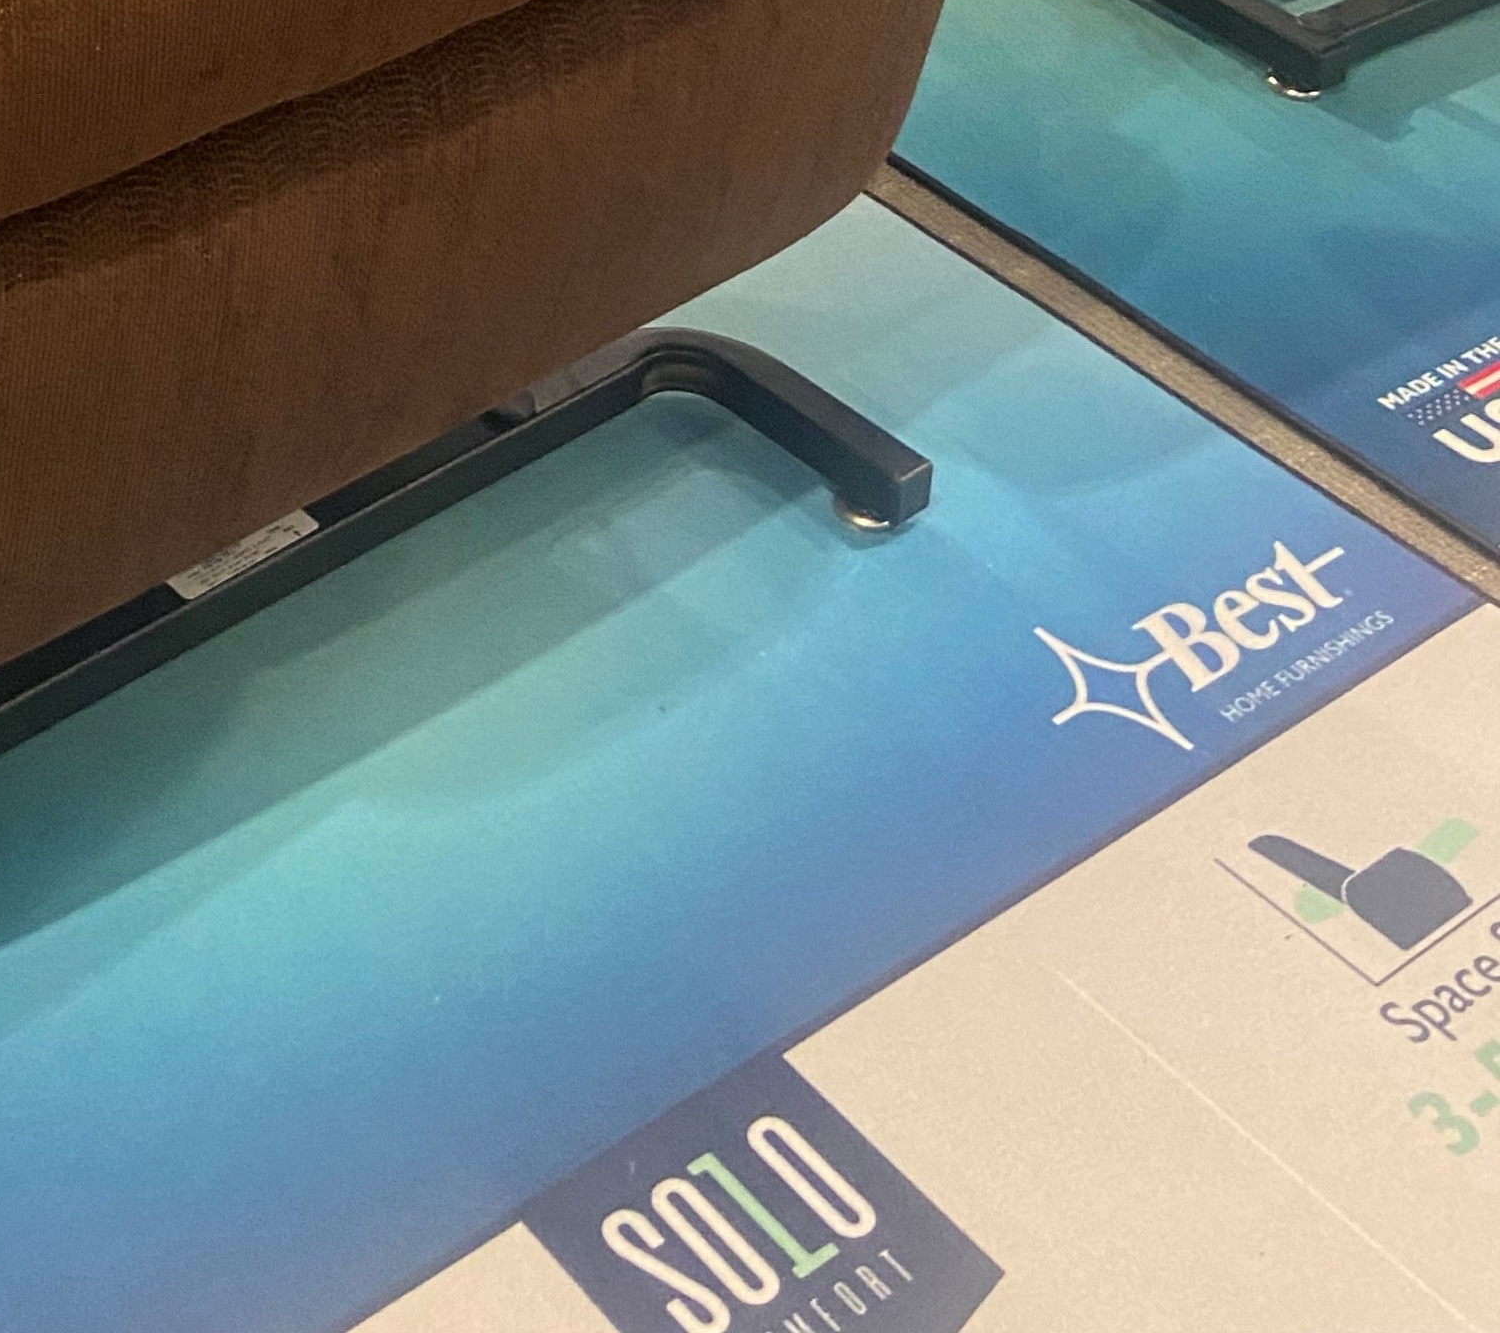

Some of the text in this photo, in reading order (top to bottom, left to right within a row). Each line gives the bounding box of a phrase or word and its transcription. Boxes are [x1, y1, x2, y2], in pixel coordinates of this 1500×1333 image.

[1377, 371, 1444, 410] MADE
[1435, 359, 1469, 380] IN
[1431, 396, 1500, 464] U
[1131, 540, 1345, 693] Best
[1219, 609, 1395, 724] HOME FURNISHINGS
[1379, 955, 1500, 1042] Space
